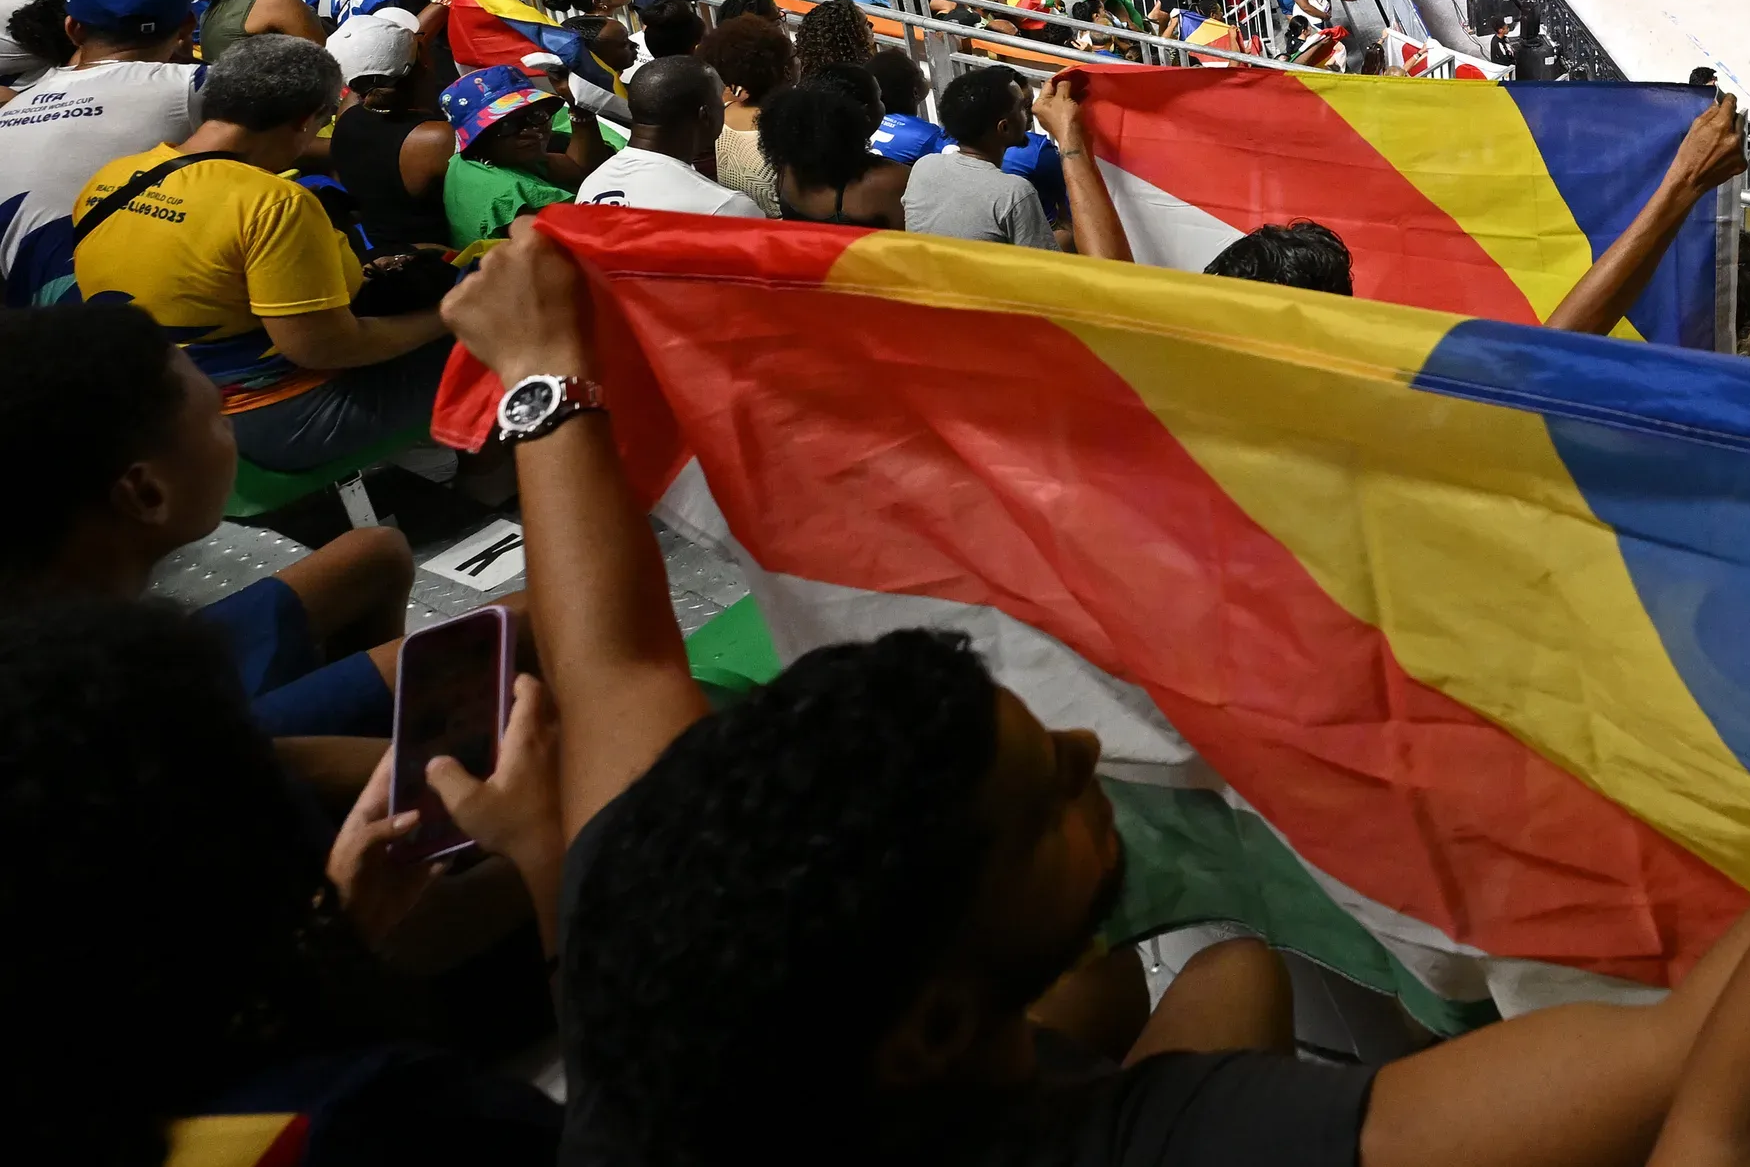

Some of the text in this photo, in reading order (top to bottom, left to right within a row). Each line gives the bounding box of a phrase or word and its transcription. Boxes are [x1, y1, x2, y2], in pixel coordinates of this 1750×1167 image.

[21, 105, 48, 115] SOCCER
[49, 99, 74, 110] WORLD
[76, 96, 95, 105] CUP
[31, 92, 67, 106] FIFA
[62, 105, 104, 119] 2025
[147, 191, 166, 202] WORLD
[166, 195, 184, 206] CUP
[151, 206, 187, 224] 2025
[454, 533, 524, 577] K
